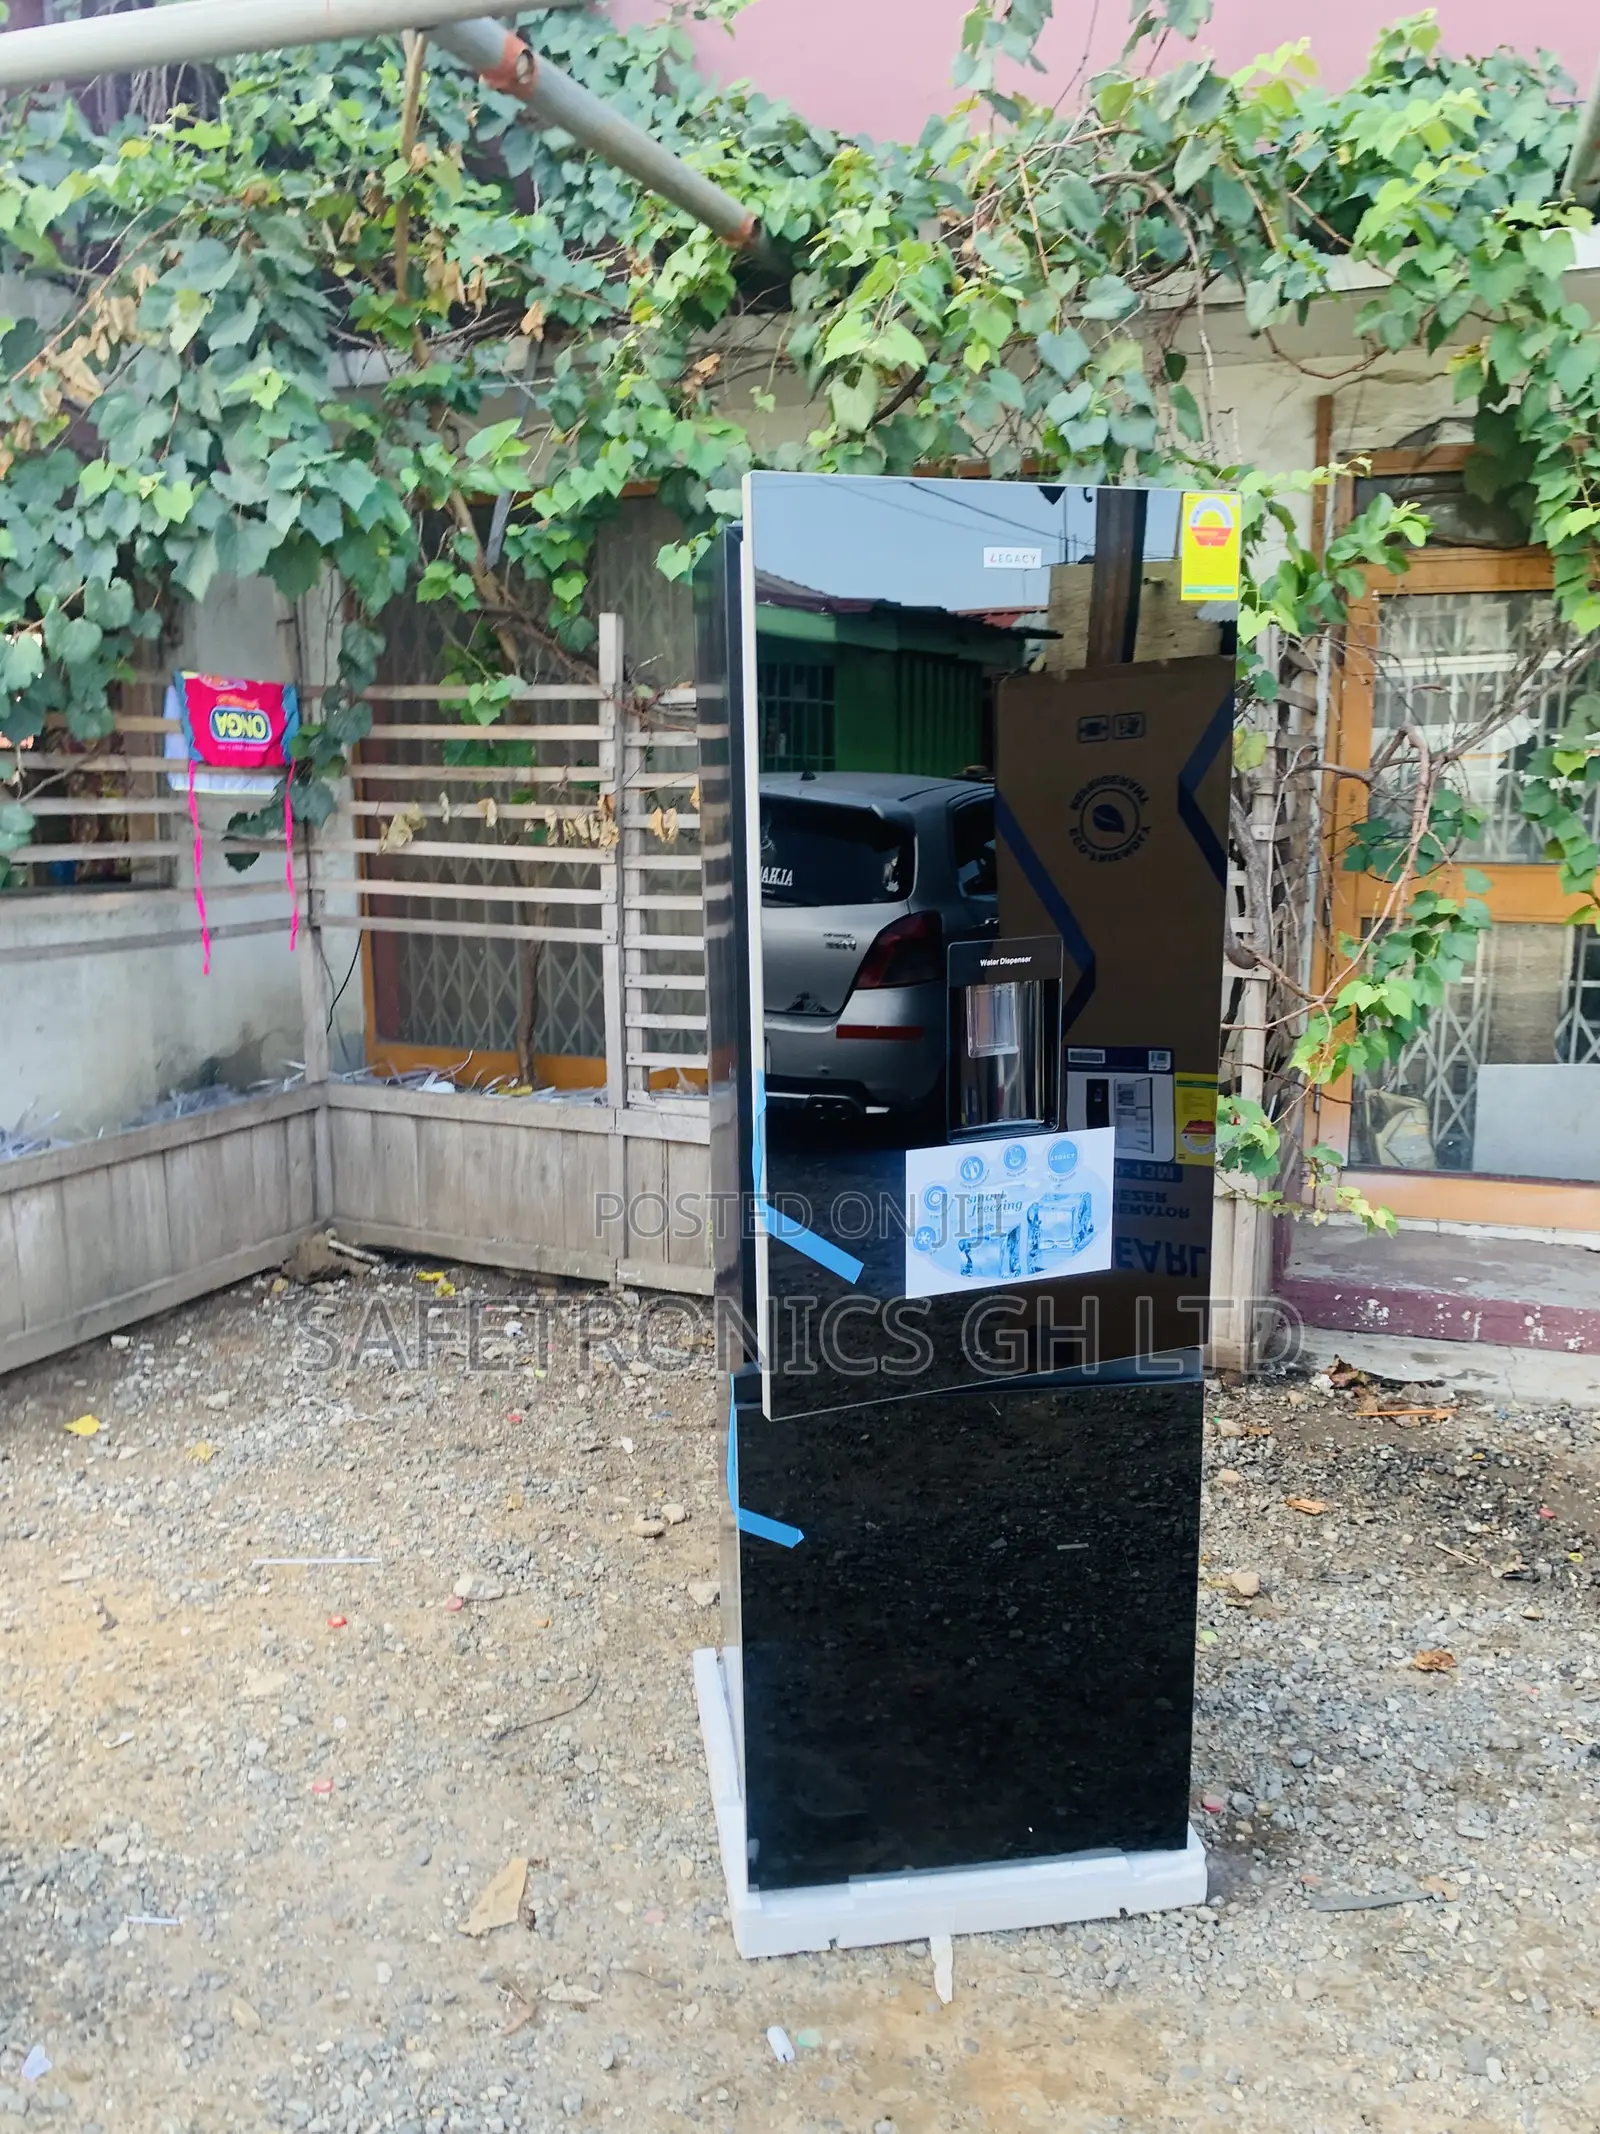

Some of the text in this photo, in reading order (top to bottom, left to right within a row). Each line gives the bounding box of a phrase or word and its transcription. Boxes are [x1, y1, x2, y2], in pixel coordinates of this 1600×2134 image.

[989, 552, 1037, 565] LEGACY
[214, 712, 267, 739] ONGA
[980, 955, 1032, 967] Water Dispenser
[967, 1189, 1008, 1204] smart
[970, 1200, 1023, 1218] freezing
